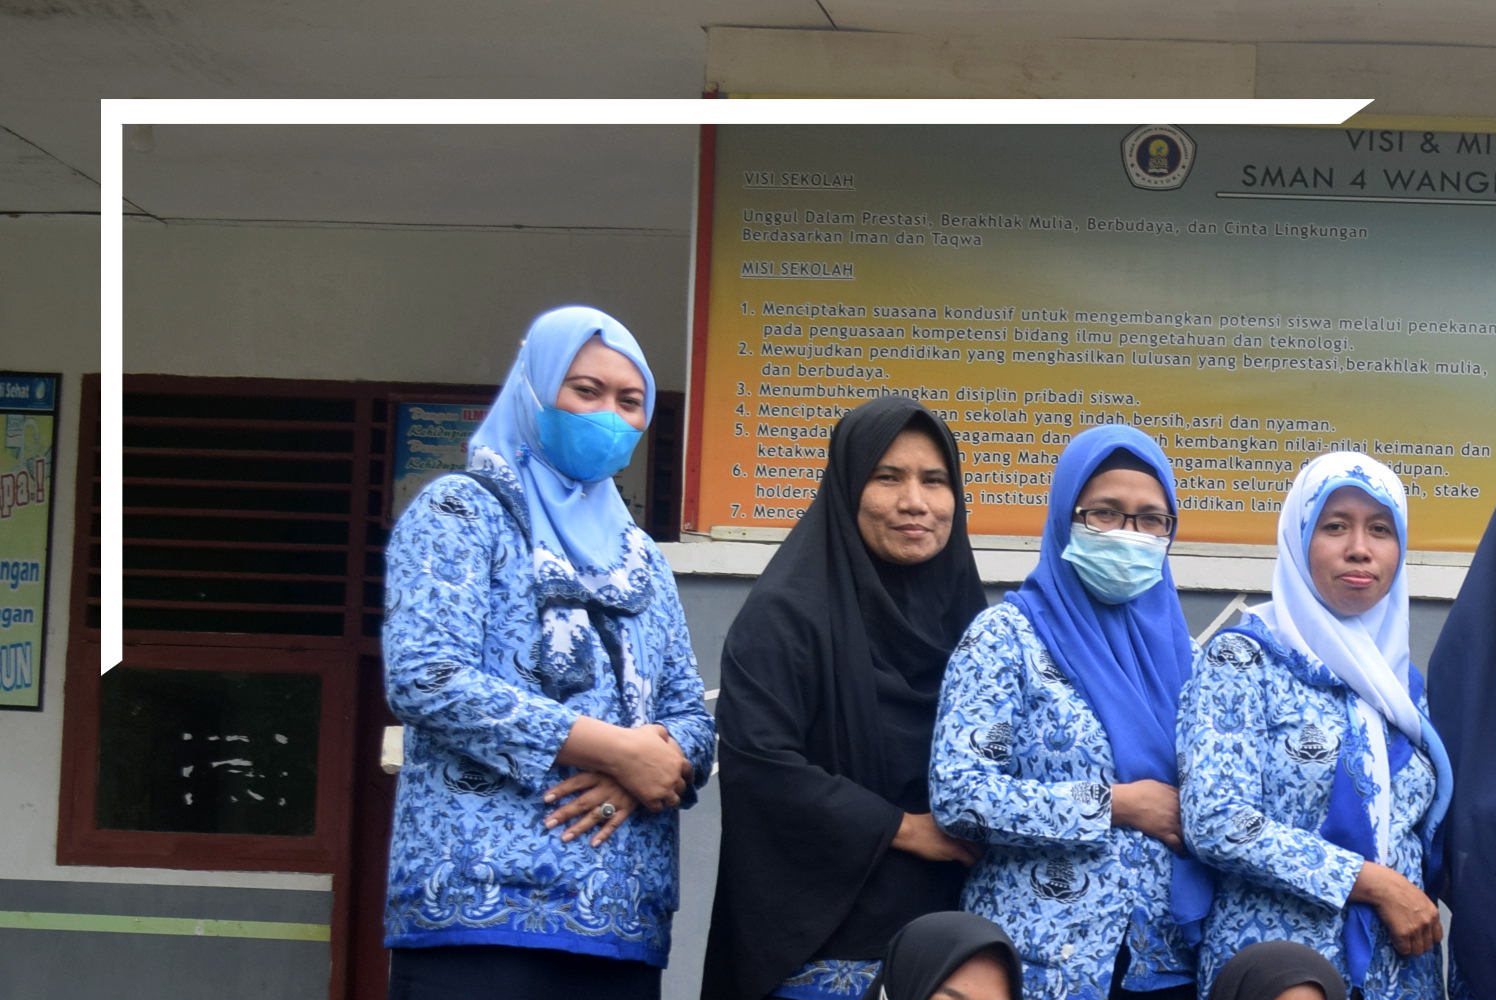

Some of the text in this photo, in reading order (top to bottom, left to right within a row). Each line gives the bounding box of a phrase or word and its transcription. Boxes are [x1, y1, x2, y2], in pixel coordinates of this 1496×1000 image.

[1345, 130, 1404, 153] VISI
[1420, 131, 1440, 153] &
[744, 172, 854, 188] VISI SEKOLAH
[1241, 164, 1334, 189] SMAN
[1349, 169, 1367, 189] 4
[742, 229, 982, 248] Berdasarkan Iman dan Taqwa
[743, 210, 1369, 241] Unggul Dalam Prestasi, Berakhlak Mulia, Berbudaya, dan Cinta Lingkungan
[742, 262, 854, 277] MISI SEKOLAH
[741, 303, 756, 316] 1.
[763, 303, 866, 320] Menciptakan
[873, 306, 937, 319] suasana
[944, 306, 1014, 321] kondusif
[1021, 308, 1068, 322] untuk
[1075, 311, 1212, 328] mengembangkan
[1219, 314, 1281, 329] potensi
[1288, 315, 1331, 330] siswa
[1339, 317, 1401, 332] melalui
[763, 323, 1354, 352] pada penguasaan kompetensi bidang ilmu pengetahuan dan teknologi.
[738, 342, 753, 356] 2.
[761, 342, 863, 360] Mewujudkan
[869, 345, 961, 361] pendidikan
[967, 349, 1005, 364] yang
[1012, 349, 1125, 366] menghasilkan
[1131, 351, 1191, 367] lulusan
[1197, 355, 1236, 370] yang
[1435, 359, 1488, 378] mulia,
[761, 362, 890, 381] dan berbudaya.
[736, 382, 1140, 407] 3. Menumbuhkembangkan disiplin pribadi siswa.
[735, 404, 750, 417] 4.
[964, 408, 1027, 424] sekolah
[1034, 412, 1073, 428] yang
[1229, 415, 1259, 430] dan
[1266, 418, 1336, 433] nyaman.
[734, 423, 750, 437] 5.
[953, 430, 1035, 445] eagamaan
[1041, 430, 1071, 445] dan
[1175, 433, 1278, 453] kembangkan
[1285, 438, 1368, 454] nilai-nilai
[1374, 440, 1454, 457] keimanan
[1461, 442, 1491, 458] dan
[757, 444, 828, 459] ketakwa
[973, 452, 1011, 467] yang
[1018, 451, 1059, 465] Maha
[1167, 456, 1293, 474] engamalkannya
[732, 464, 748, 478] 6.
[754, 464, 826, 481] Menerap
[964, 470, 1052, 487] partisipati
[1233, 477, 1293, 492] seluruh
[1435, 484, 1480, 498] stake
[730, 504, 806, 520] 7. Mence
[756, 484, 818, 500] holders
[980, 490, 1048, 506] institusi
[1176, 496, 1244, 511] ndidikan
[1251, 498, 1282, 512] lain
[0, 561, 40, 590] ngan
